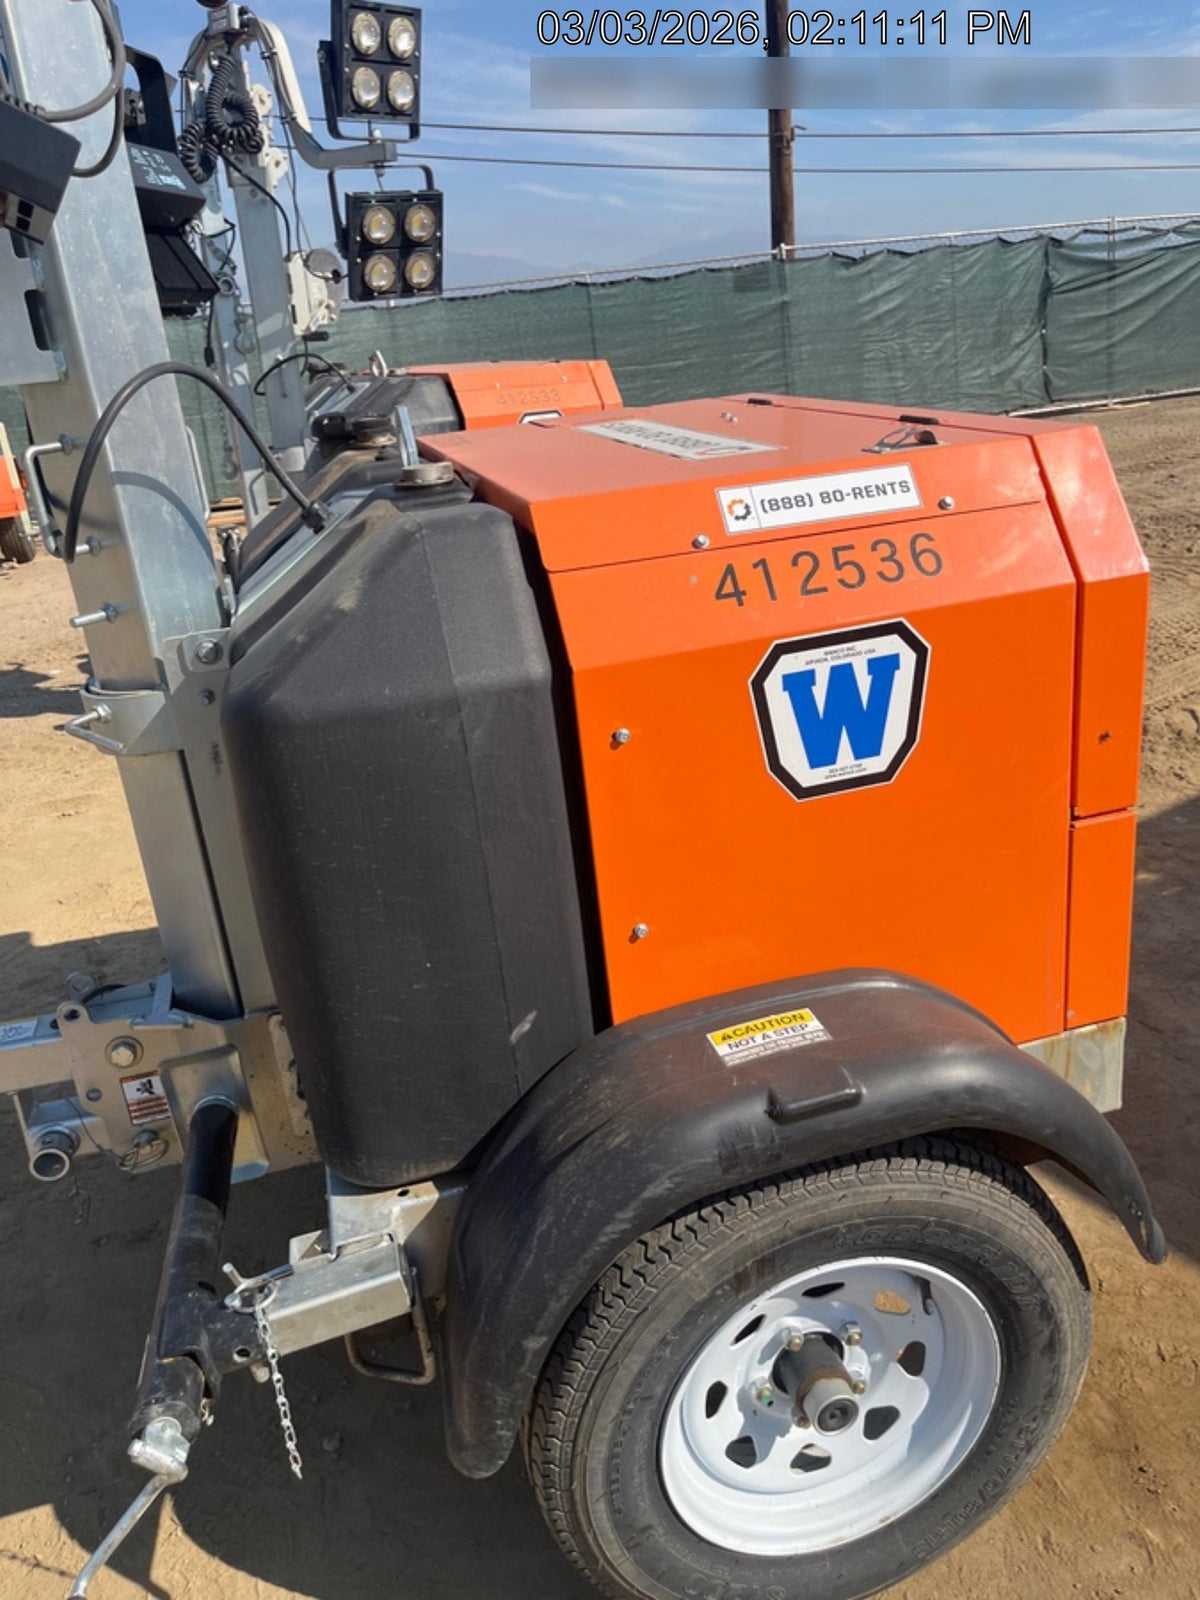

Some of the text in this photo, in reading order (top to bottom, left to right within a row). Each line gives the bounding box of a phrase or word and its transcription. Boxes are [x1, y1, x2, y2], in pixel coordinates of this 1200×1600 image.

[760, 480, 911, 514] (888) 80-RENTS
[714, 532, 943, 607] 412536
[782, 652, 900, 770] W
[728, 1023, 809, 1051] NOT A STEP
[732, 1013, 805, 1037] CAUTION
